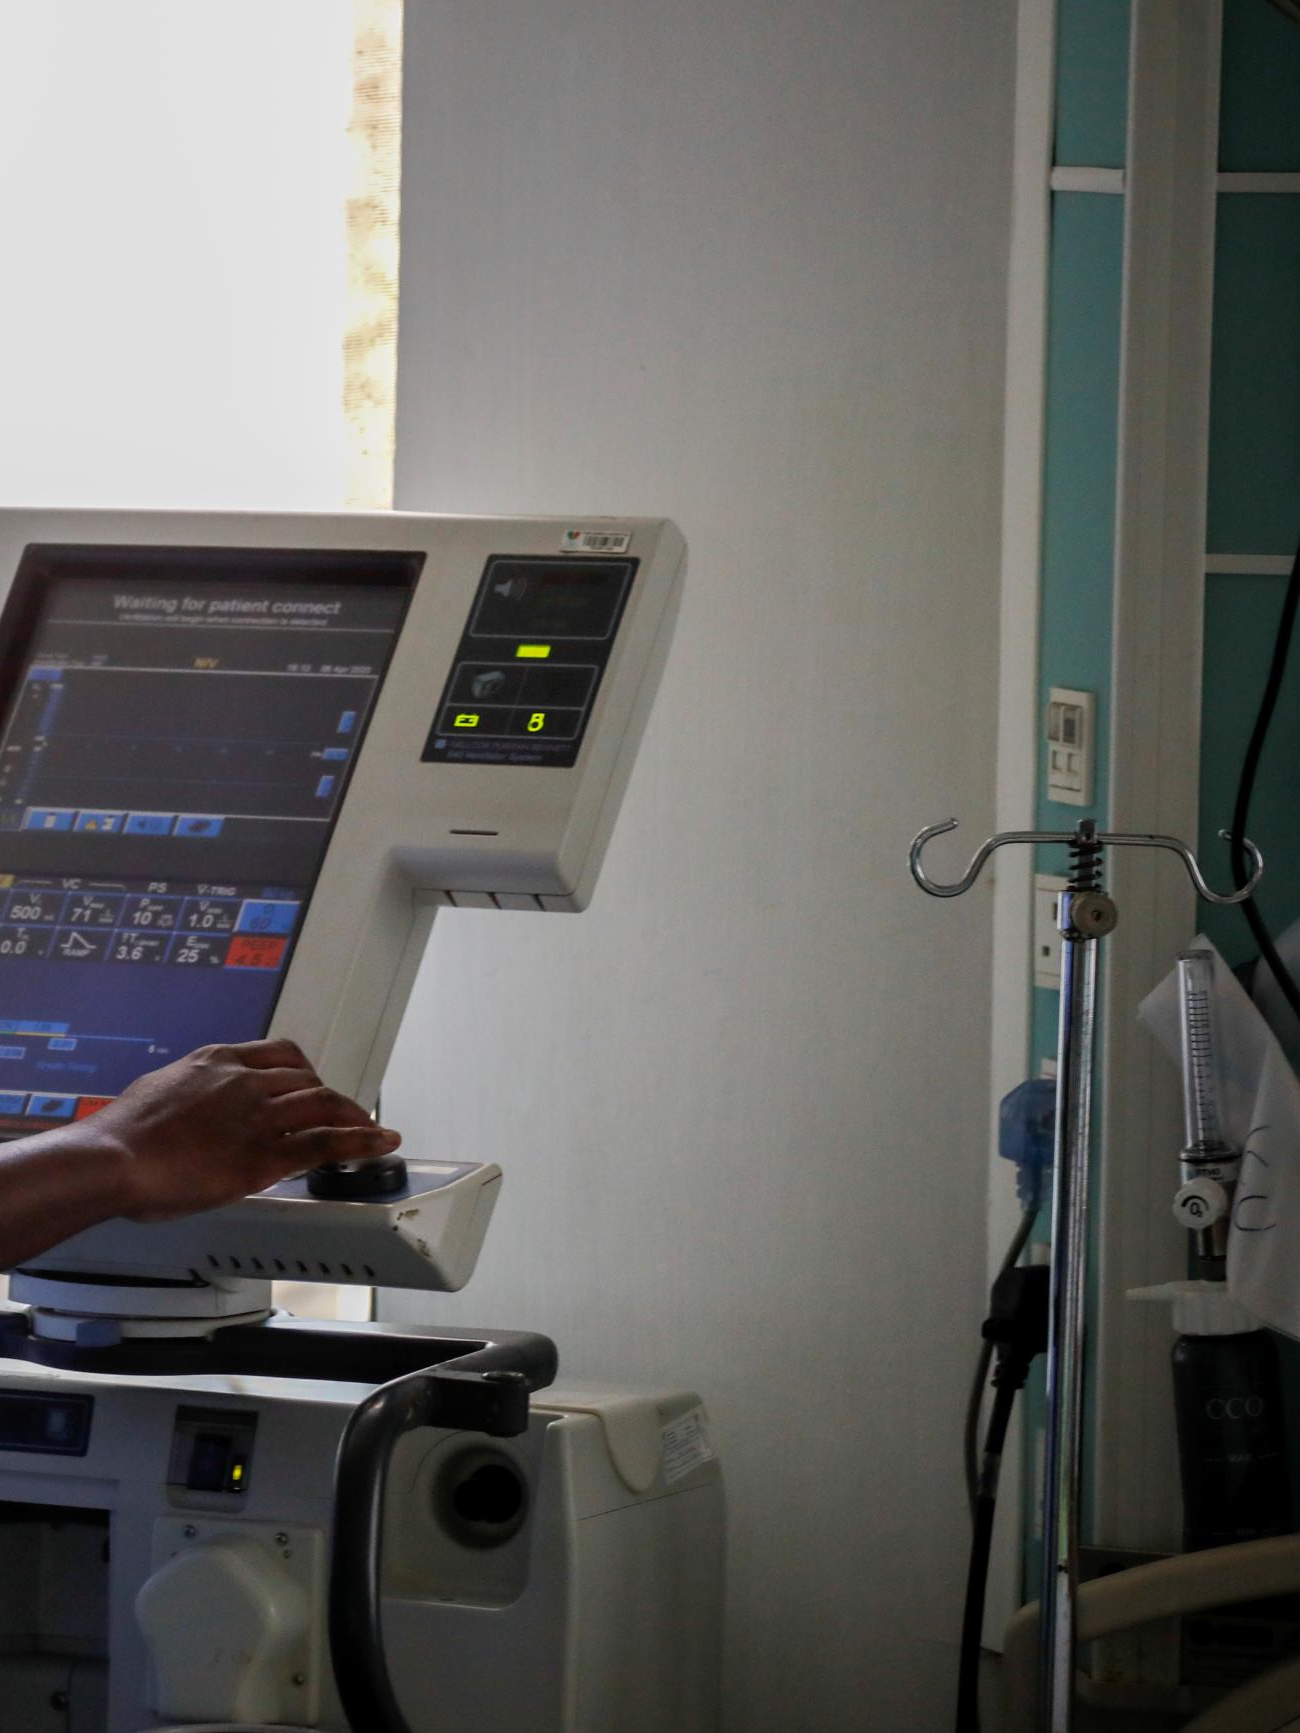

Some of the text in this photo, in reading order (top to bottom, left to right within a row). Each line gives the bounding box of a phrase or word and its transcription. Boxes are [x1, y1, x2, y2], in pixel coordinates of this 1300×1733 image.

[113, 595, 341, 615] Waiting for patient connect
[62, 878, 81, 890] VC
[148, 882, 167, 893] PS
[10, 905, 42, 920] 500
[71, 908, 92, 922] 71
[132, 911, 152, 926] 10
[189, 913, 214, 928] 1.0
[0, 941, 27, 954] 0.0
[116, 946, 143, 960] 3.6
[176, 949, 200, 963] 25
